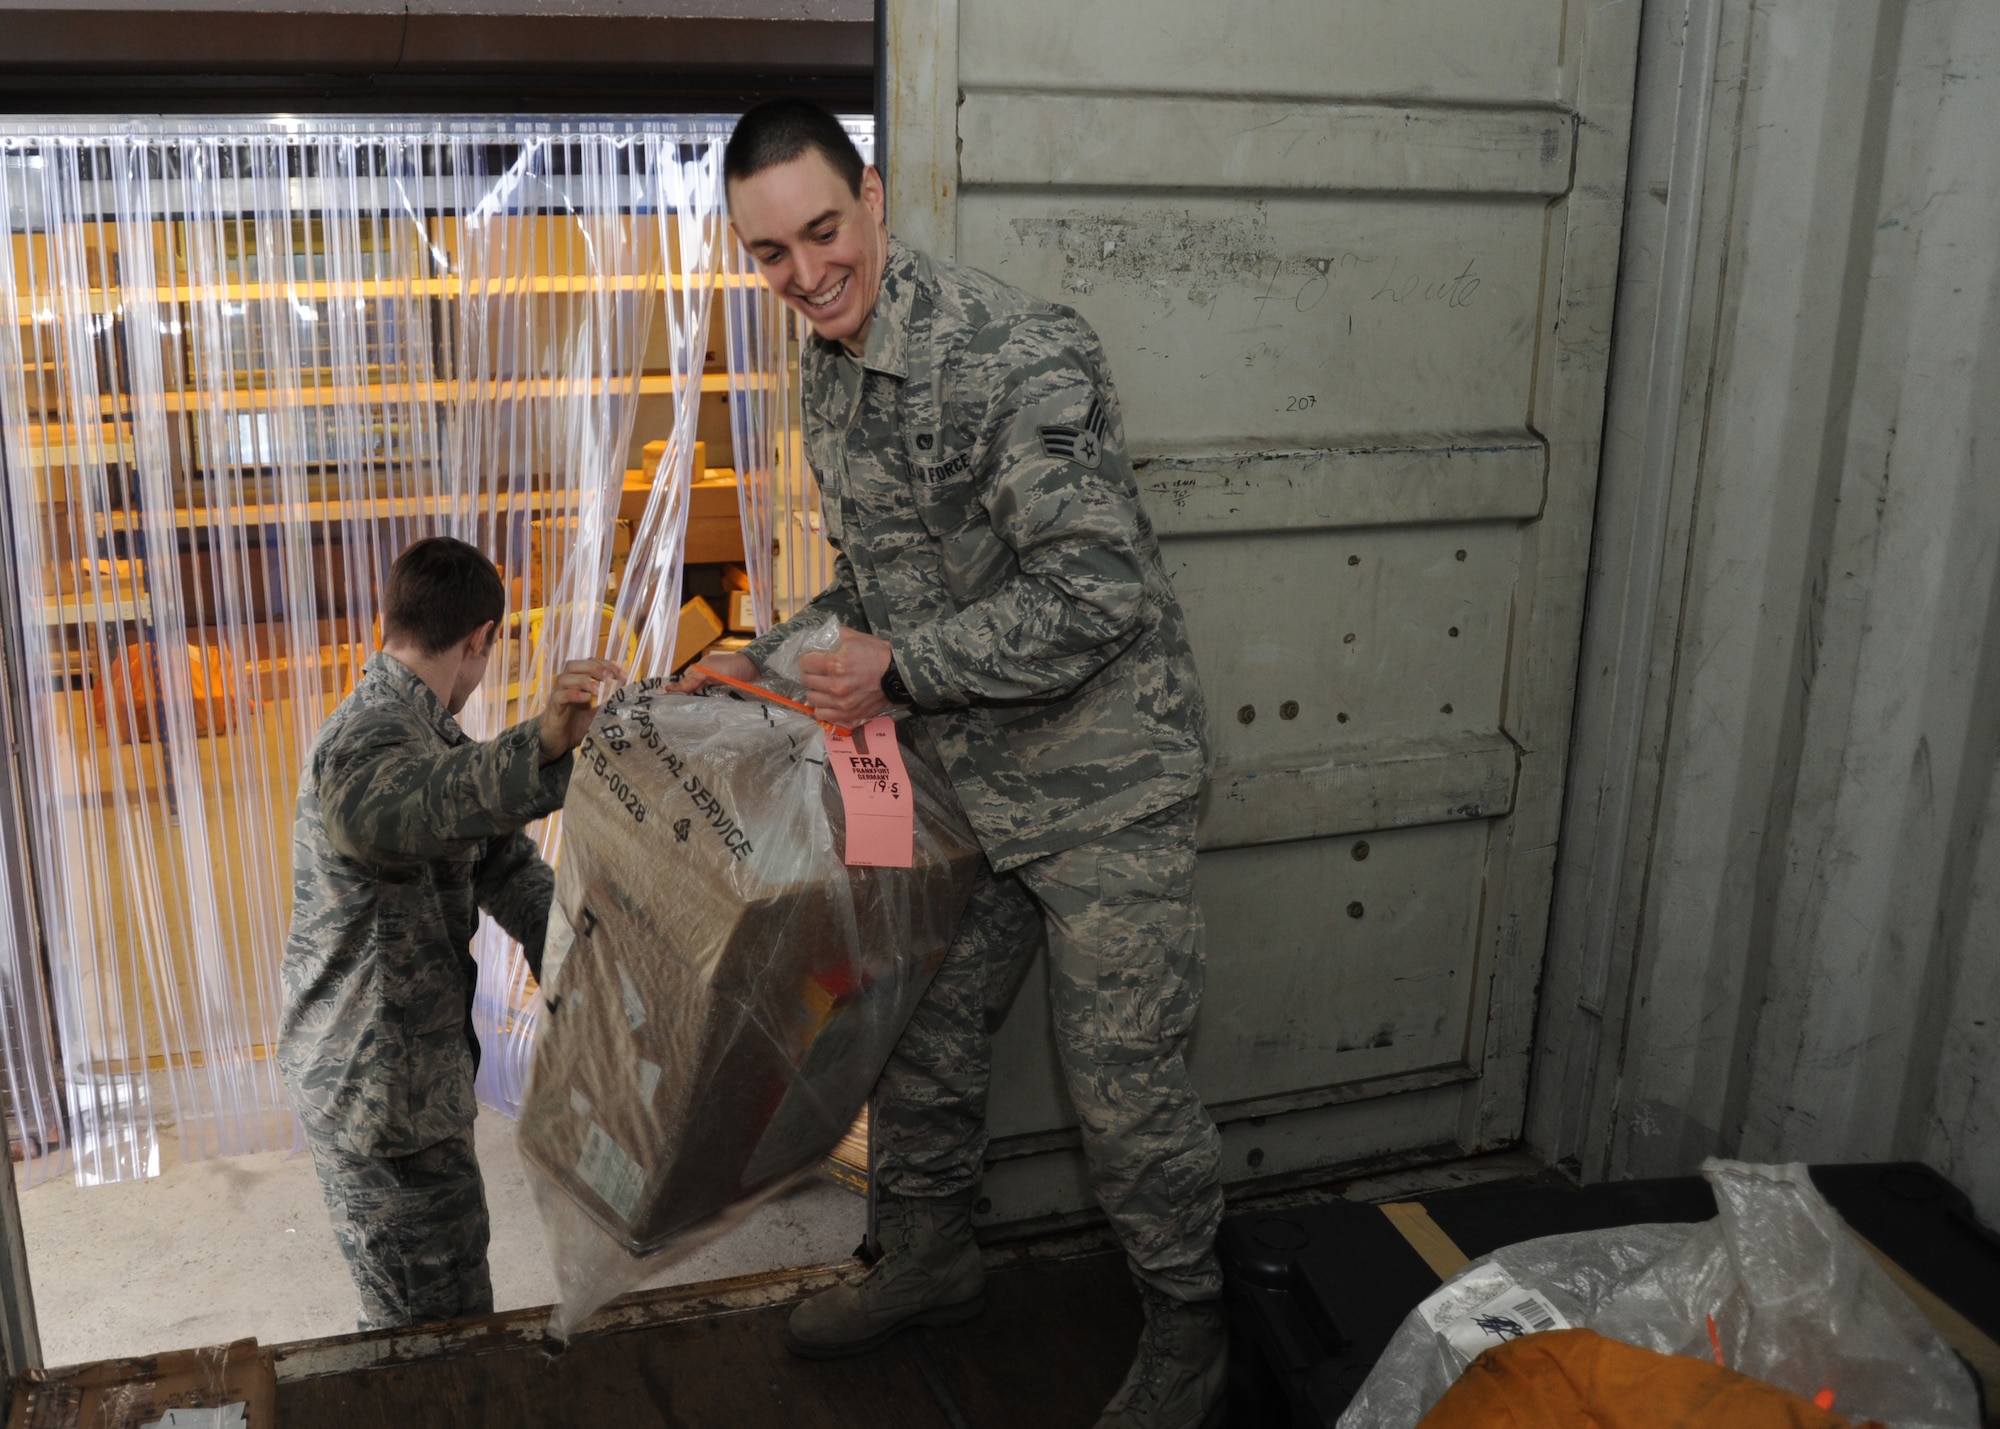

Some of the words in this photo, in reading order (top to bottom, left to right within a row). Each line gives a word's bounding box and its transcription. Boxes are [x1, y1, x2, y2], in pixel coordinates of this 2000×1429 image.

[1286, 395, 1317, 412] 207
[929, 452, 970, 483] FORCE
[849, 756, 887, 768] FRA
[638, 712, 685, 778] POSTAL
[683, 772, 754, 862] SERVICE
